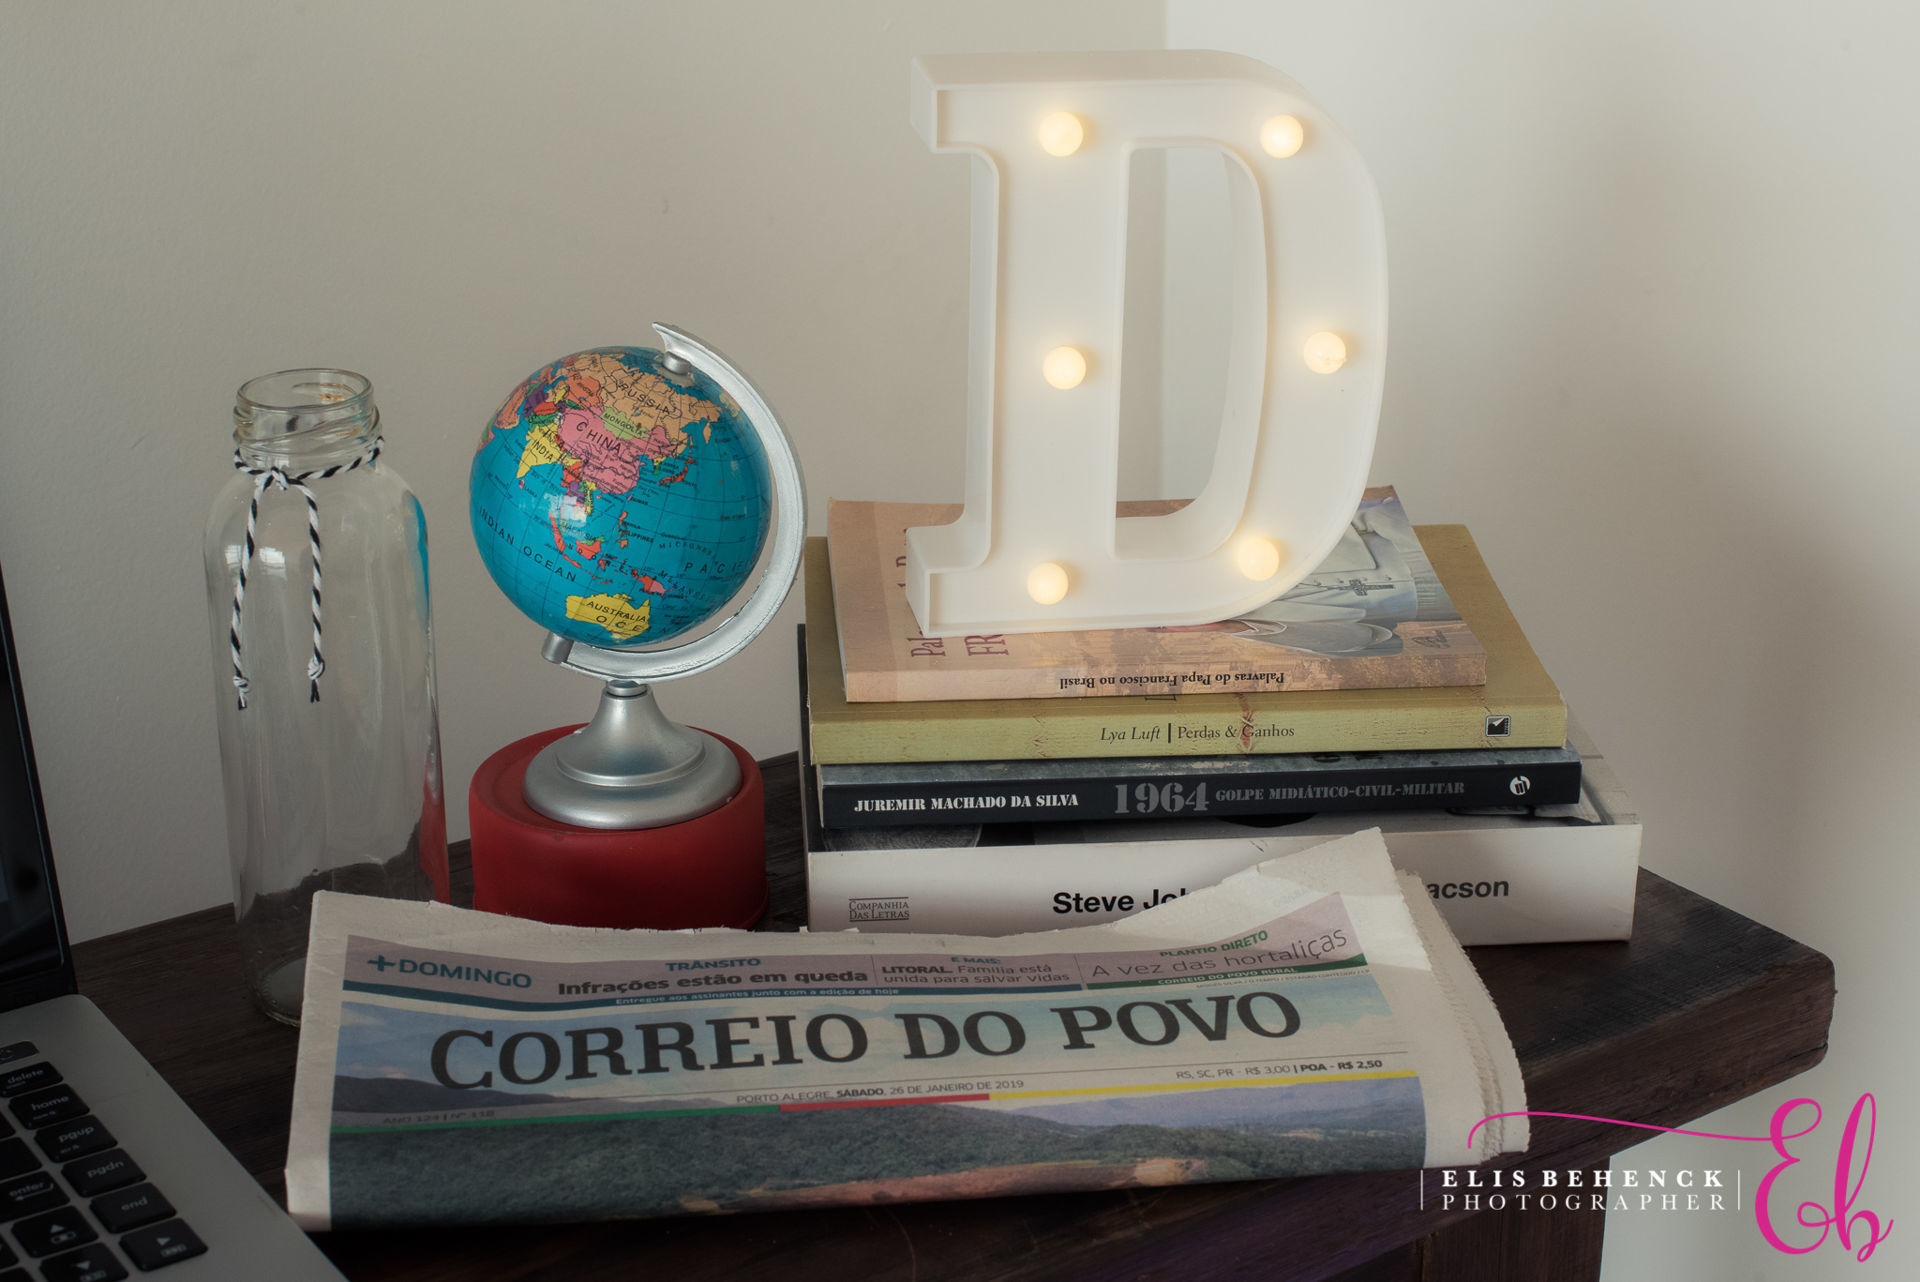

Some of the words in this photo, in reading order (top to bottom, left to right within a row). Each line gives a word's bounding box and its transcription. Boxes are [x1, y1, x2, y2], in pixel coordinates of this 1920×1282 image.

[618, 382, 671, 415] RUSSIA
[604, 413, 645, 437] MONGOLIA
[576, 421, 621, 454] CHINA
[531, 440, 554, 462] INDIA
[479, 505, 514, 545] INDIAN
[523, 545, 577, 582] OCEAN
[587, 601, 646, 623] AUSTRALIA
[1060, 677, 1095, 690] Brasil
[1099, 677, 1115, 686] no
[1119, 675, 1177, 687] Francisco
[1181, 671, 1211, 686] Papa
[1215, 673, 1231, 684] do
[1234, 671, 1284, 684] Palavras
[1100, 727, 1126, 744] Lya
[1131, 725, 1161, 743] Luft
[1177, 725, 1221, 740] Perdas
[1224, 725, 1237, 738] &
[1241, 723, 1295, 739] Ganhos
[854, 798, 926, 812] JUREMIR
[930, 796, 1007, 810] MACHADO
[1010, 795, 1032, 808] DA
[1035, 793, 1079, 807] SILVA
[1114, 782, 1210, 815] 1964
[1215, 788, 1264, 801] GOLPE
[849, 900, 909, 911] COMPANHIA
[1053, 892, 1134, 914] Steve
[871, 910, 910, 920] LETRAS
[1160, 946, 1217, 957] PLANTIO
[1221, 930, 1269, 952] DIRETO
[1091, 965, 1110, 977] A
[1116, 962, 1162, 976] vez
[1172, 957, 1217, 973] das
[1223, 929, 1348, 968] hortaliças
[666, 957, 761, 972] TRÂNSITO
[958, 965, 1014, 974] Família
[1019, 963, 1052, 973] está
[558, 980, 669, 996] Infrações
[677, 974, 742, 987] estão
[750, 973, 787, 983] em
[794, 971, 868, 984] queda
[884, 974, 928, 983] unida
[933, 974, 968, 985] para
[974, 973, 1021, 983] salvar
[1026, 972, 1070, 982] vidas
[1158, 975, 1206, 985] CORREIO
[1208, 973, 1224, 981] DO
[1226, 970, 1258, 979] POVO
[1261, 967, 1298, 977] RURAL
[616, 996, 666, 1005] Entregue
[691, 991, 749, 1001] assinantes
[751, 989, 781, 998] junto
[819, 988, 856, 997] edição
[875, 987, 899, 996] hoje
[430, 1013, 869, 1090] CORREIO
[895, 1010, 1027, 1060] DO
[1049, 991, 1301, 1051] POVO
[7, 1068, 45, 1084] delete
[1176, 1070, 1195, 1080] RS,
[1196, 1069, 1215, 1079] SC,
[1217, 1068, 1234, 1078] PR
[1244, 1066, 1261, 1076] R$
[1299, 1063, 1327, 1073] POA
[1337, 1061, 1354, 1071] R$
[1356, 1059, 1383, 1069] 2,50
[737, 1093, 779, 1104] PORTO
[782, 1090, 833, 1102] ALEGRE,
[889, 1086, 905, 1096] 26
[907, 1084, 924, 1094] DE
[925, 1081, 974, 1093] JANEIRO
[977, 1081, 993, 1091] DE
[995, 1079, 1025, 1089] 2019
[31, 1096, 70, 1111] home
[59, 1126, 95, 1143] pgup
[87, 1161, 125, 1178] pgdn
[8, 1182, 45, 1197] enter
[121, 1196, 149, 1211] end
